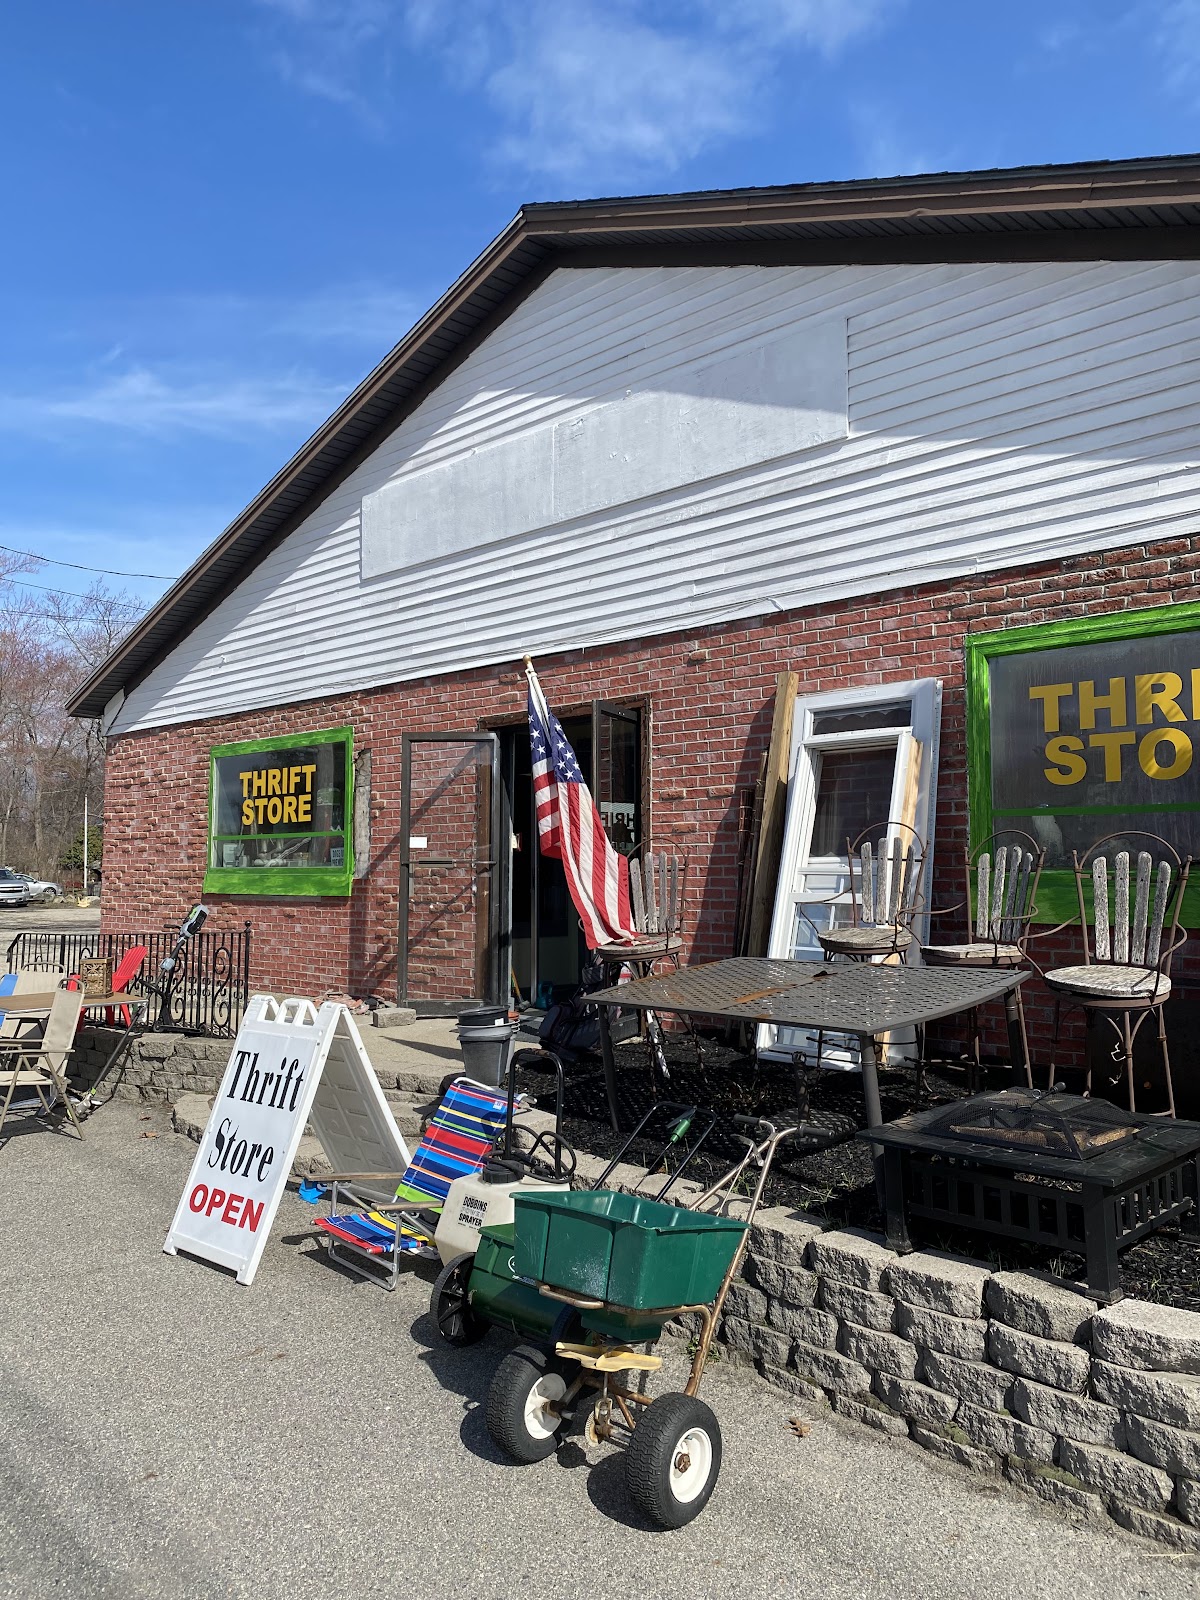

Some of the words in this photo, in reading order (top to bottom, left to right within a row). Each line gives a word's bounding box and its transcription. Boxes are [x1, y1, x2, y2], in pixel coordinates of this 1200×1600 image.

[1044, 727, 1193, 786] STO
[240, 764, 316, 798] THRIFT
[242, 794, 311, 826] STORE
[226, 1050, 306, 1112] Thrift
[207, 1117, 274, 1182] Store
[189, 1183, 265, 1233] OPEN
[458, 1212, 483, 1228] SPRAYER
[462, 1196, 488, 1212] DOBBINS
